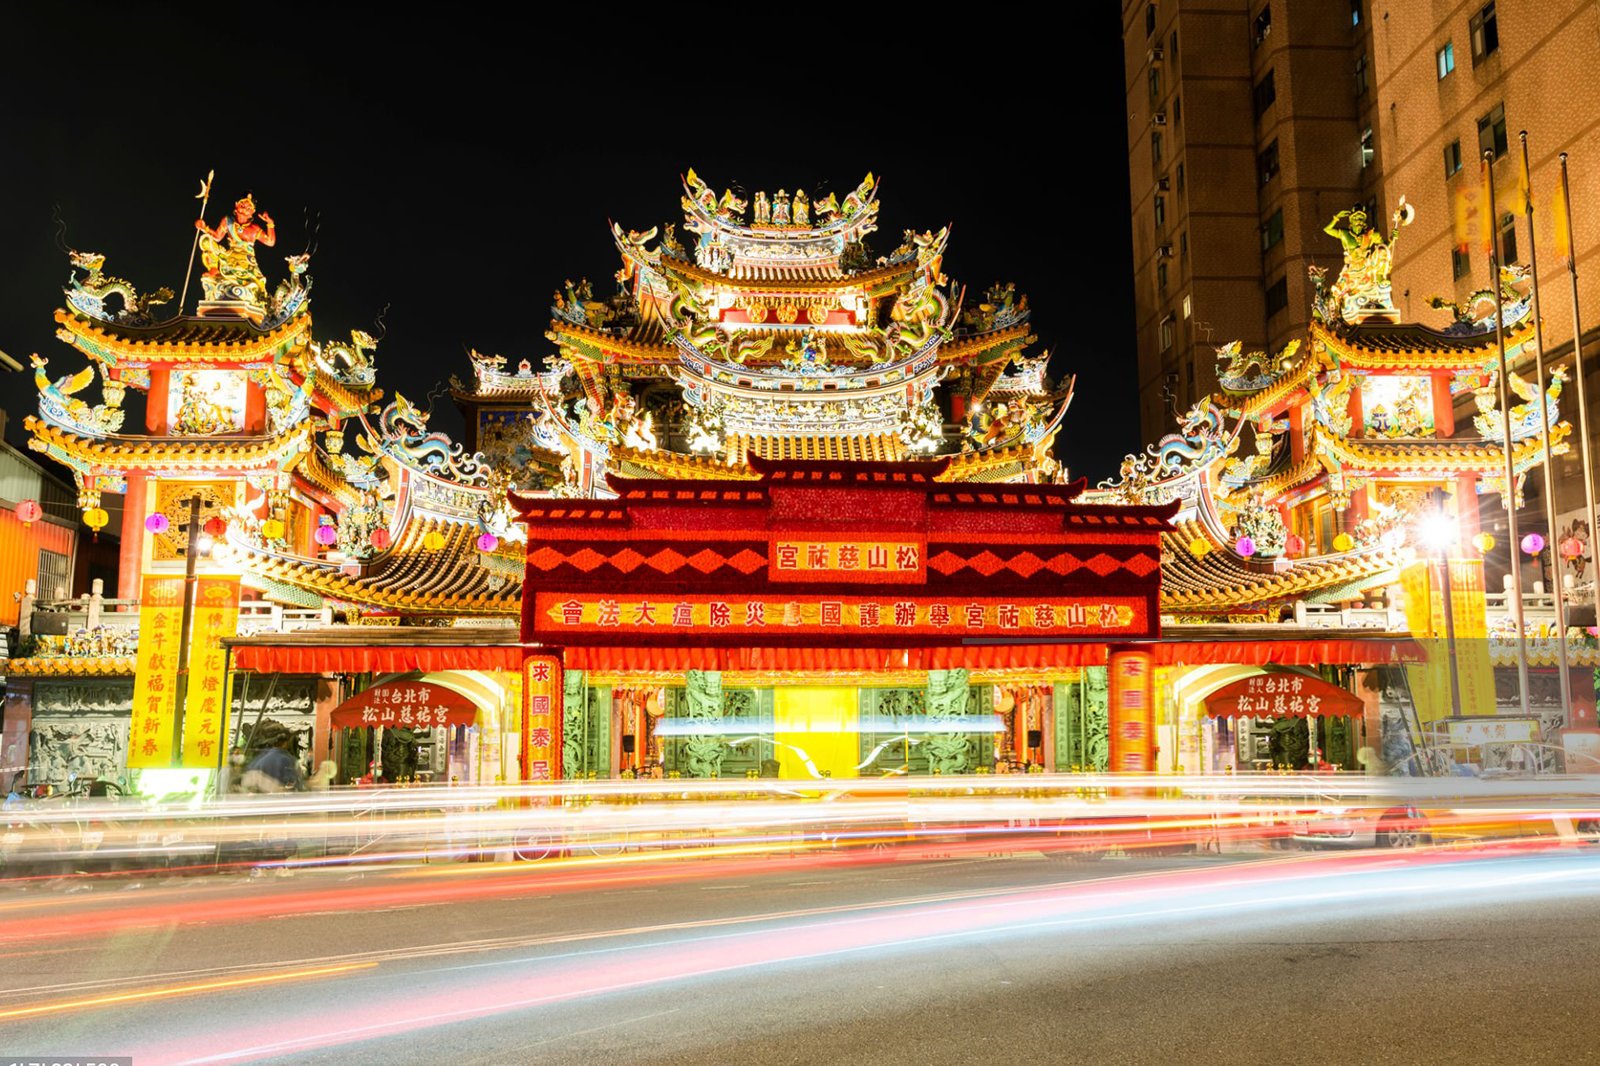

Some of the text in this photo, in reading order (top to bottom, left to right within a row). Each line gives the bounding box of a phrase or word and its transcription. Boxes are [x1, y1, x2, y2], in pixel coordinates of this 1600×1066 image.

[777, 544, 919, 571] 松山慈祐宮
[1265, 677, 1303, 694] 台北市
[391, 688, 431, 704] 台北市
[1237, 695, 1321, 713] 松山慈祐宮
[362, 705, 449, 723] 松山慈祐宮
